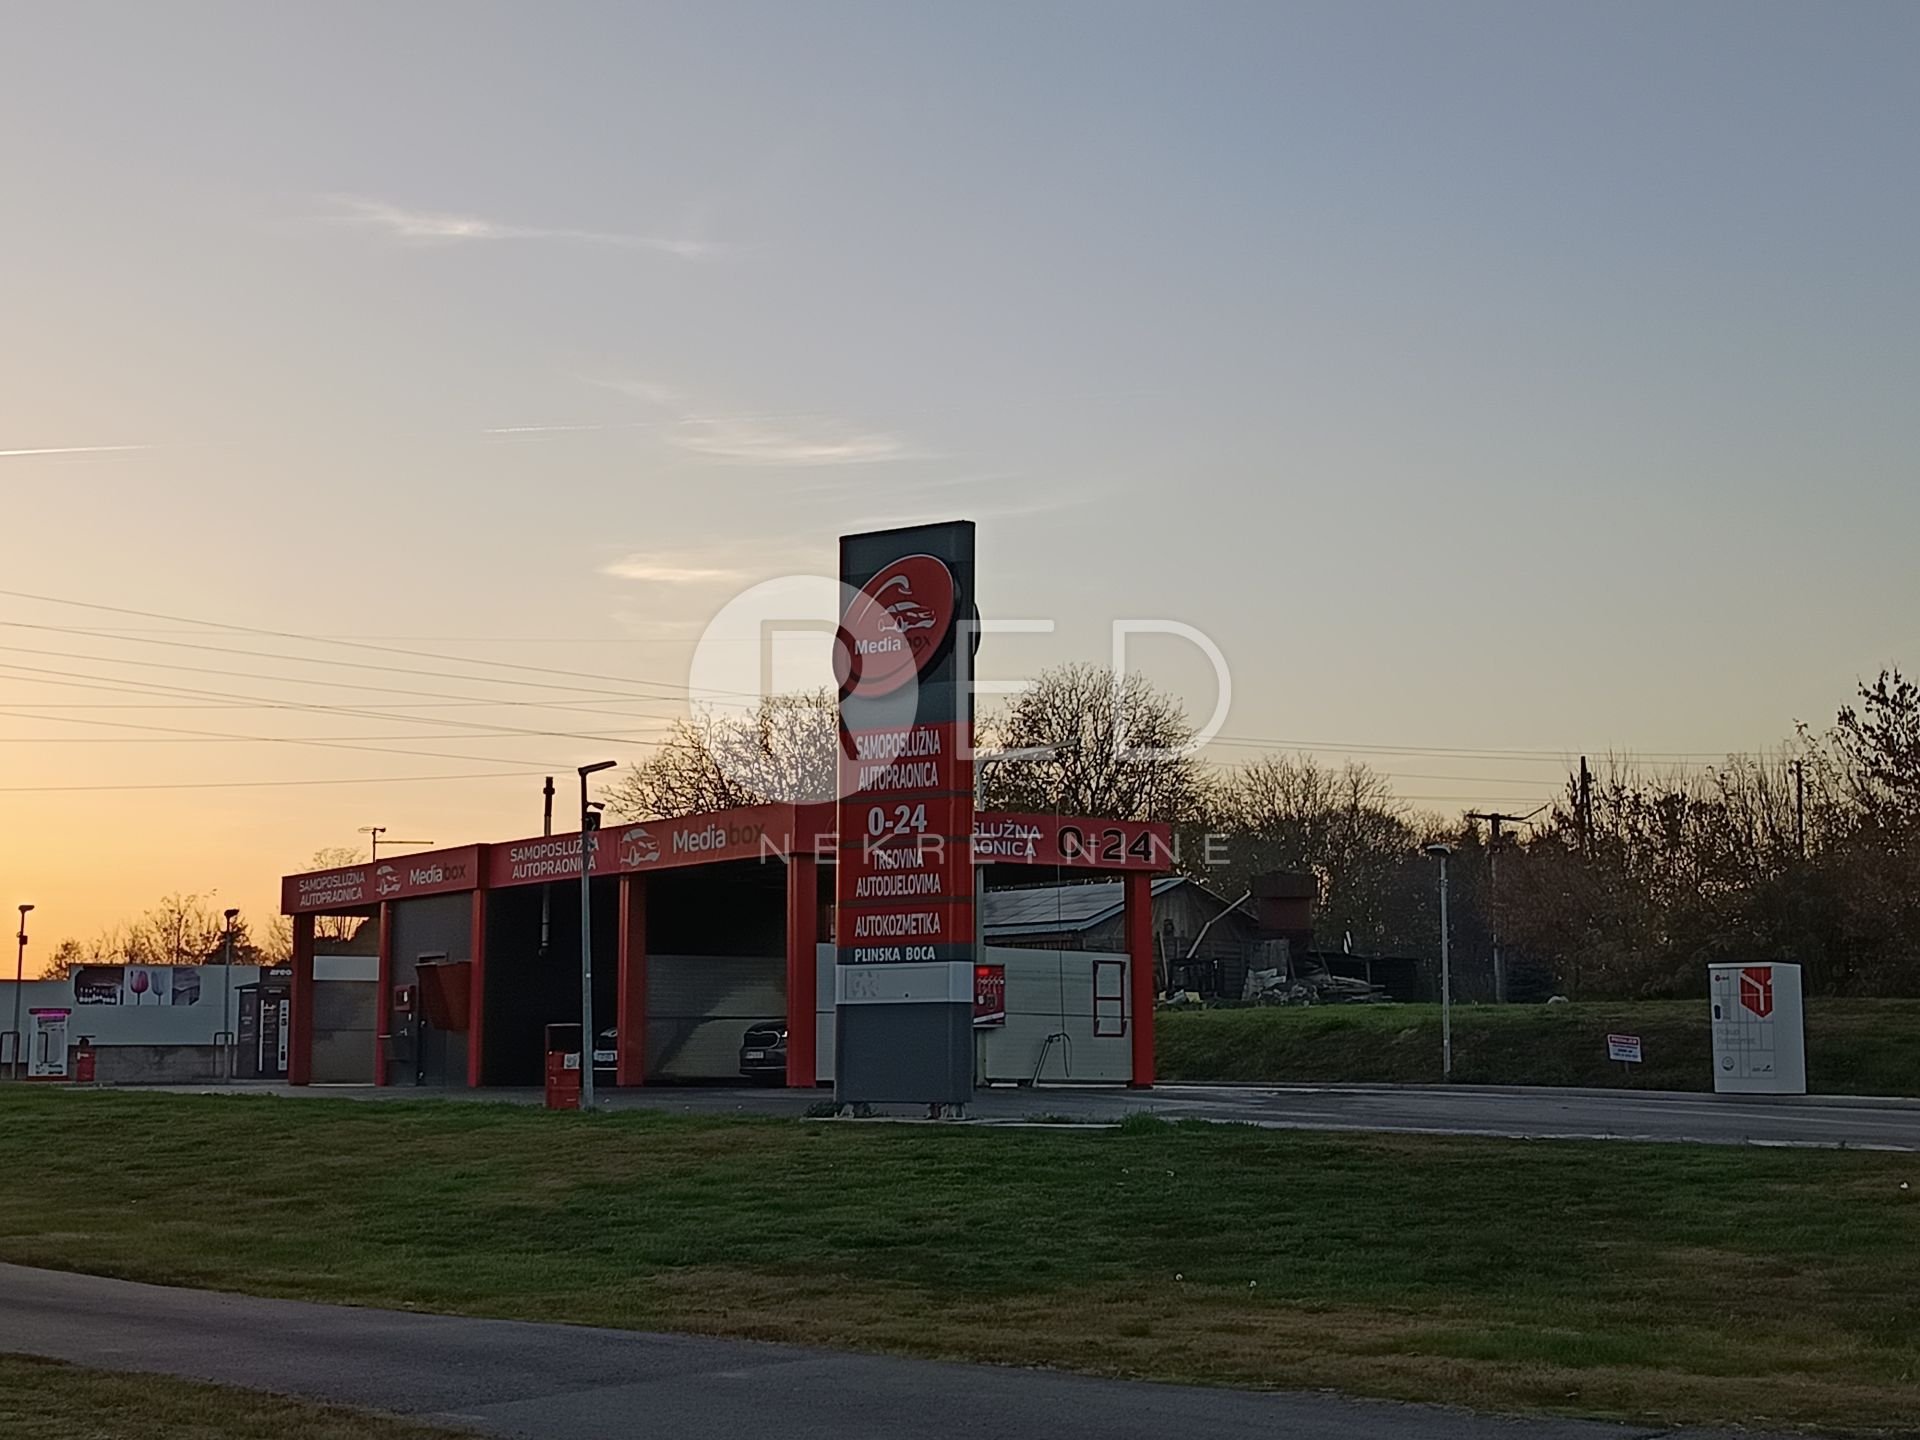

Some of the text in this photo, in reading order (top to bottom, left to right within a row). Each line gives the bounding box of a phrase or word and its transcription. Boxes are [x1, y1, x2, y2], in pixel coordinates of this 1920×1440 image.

[856, 726, 941, 760] SAMOPOSLUŽNA
[858, 761, 939, 792] AUTOPRAONICA
[868, 804, 927, 836] 0-24
[873, 847, 924, 871] TRGOVINA
[1056, 825, 1153, 863] 0-24
[855, 912, 941, 937] AUTOKOZMETIKA
[855, 946, 936, 962] PLINSKA BOCA
